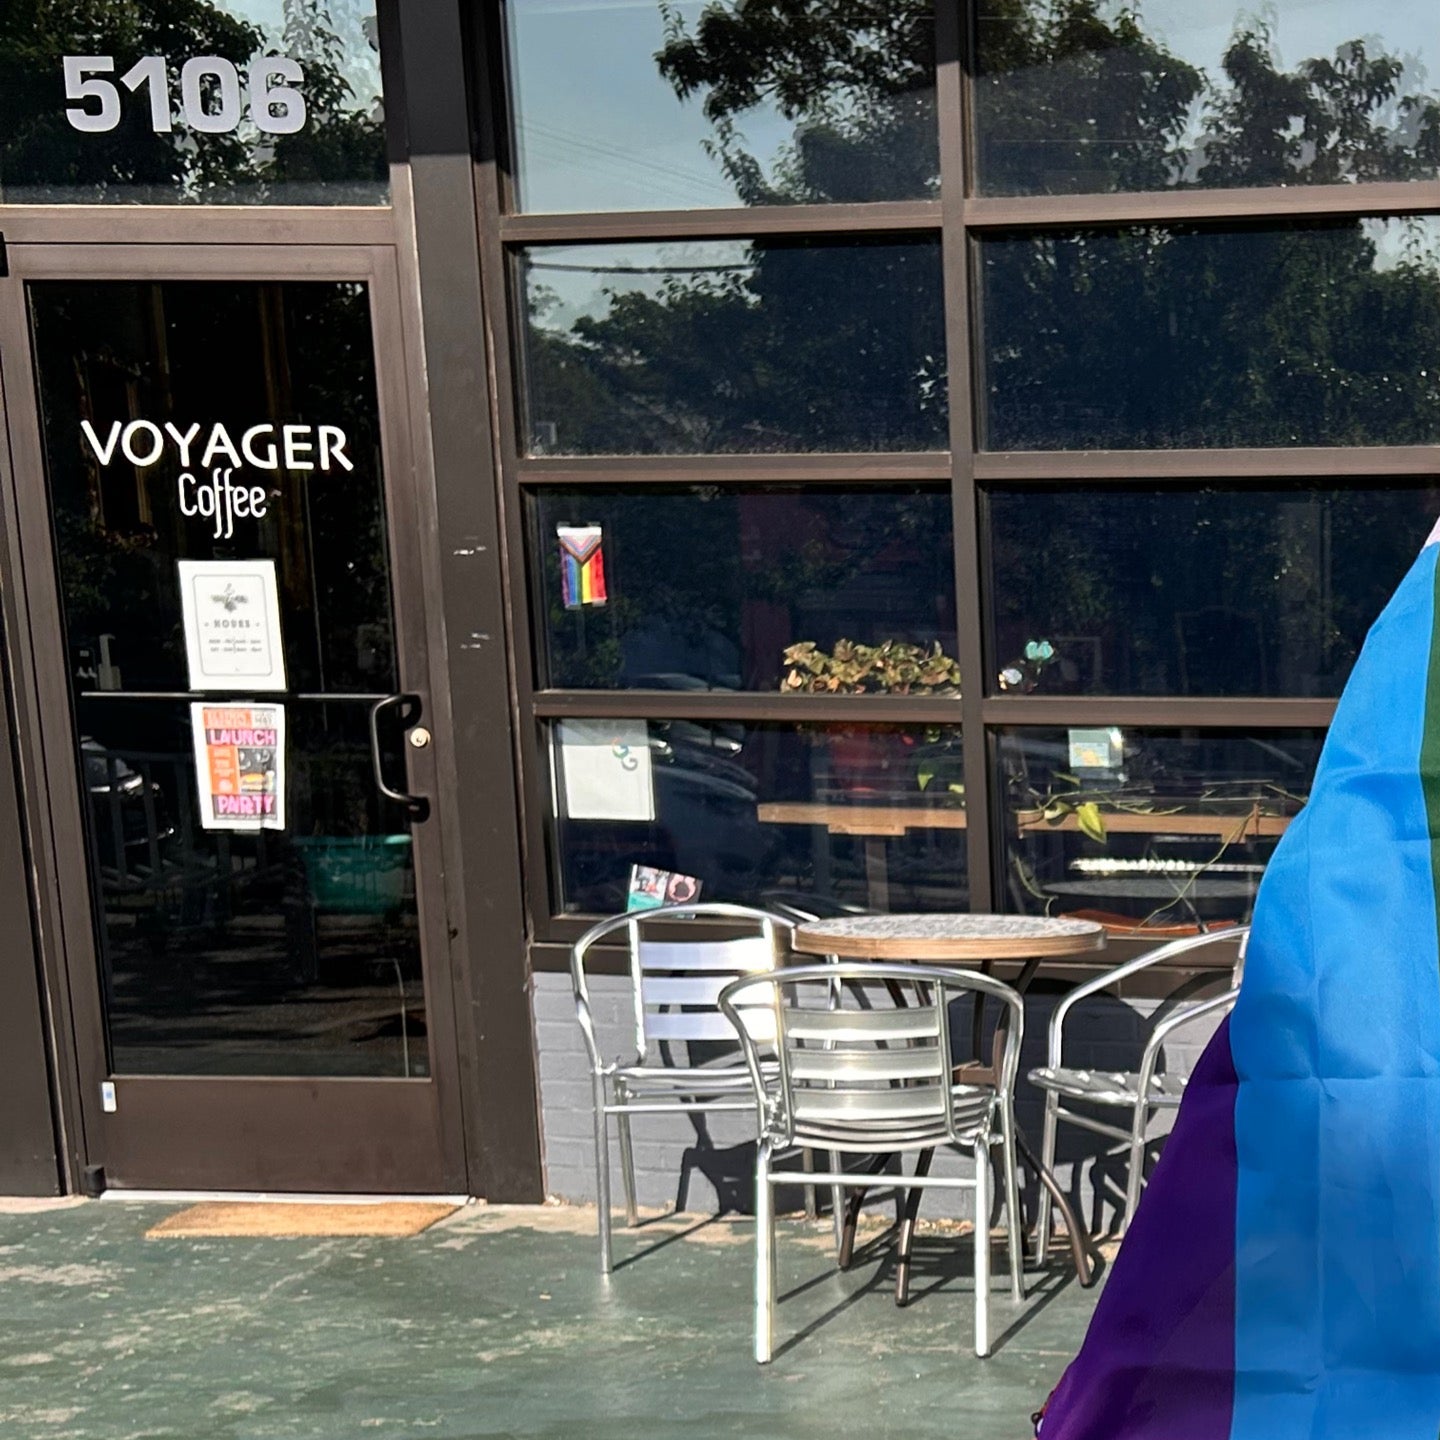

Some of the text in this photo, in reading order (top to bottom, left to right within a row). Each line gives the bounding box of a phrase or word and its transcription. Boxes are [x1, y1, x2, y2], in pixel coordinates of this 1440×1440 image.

[63, 55, 307, 135] 5106
[80, 419, 354, 472] VOYAGER
[178, 467, 267, 539] Coffee
[209, 729, 276, 746] LAUNCH
[217, 794, 275, 815] PARTY
